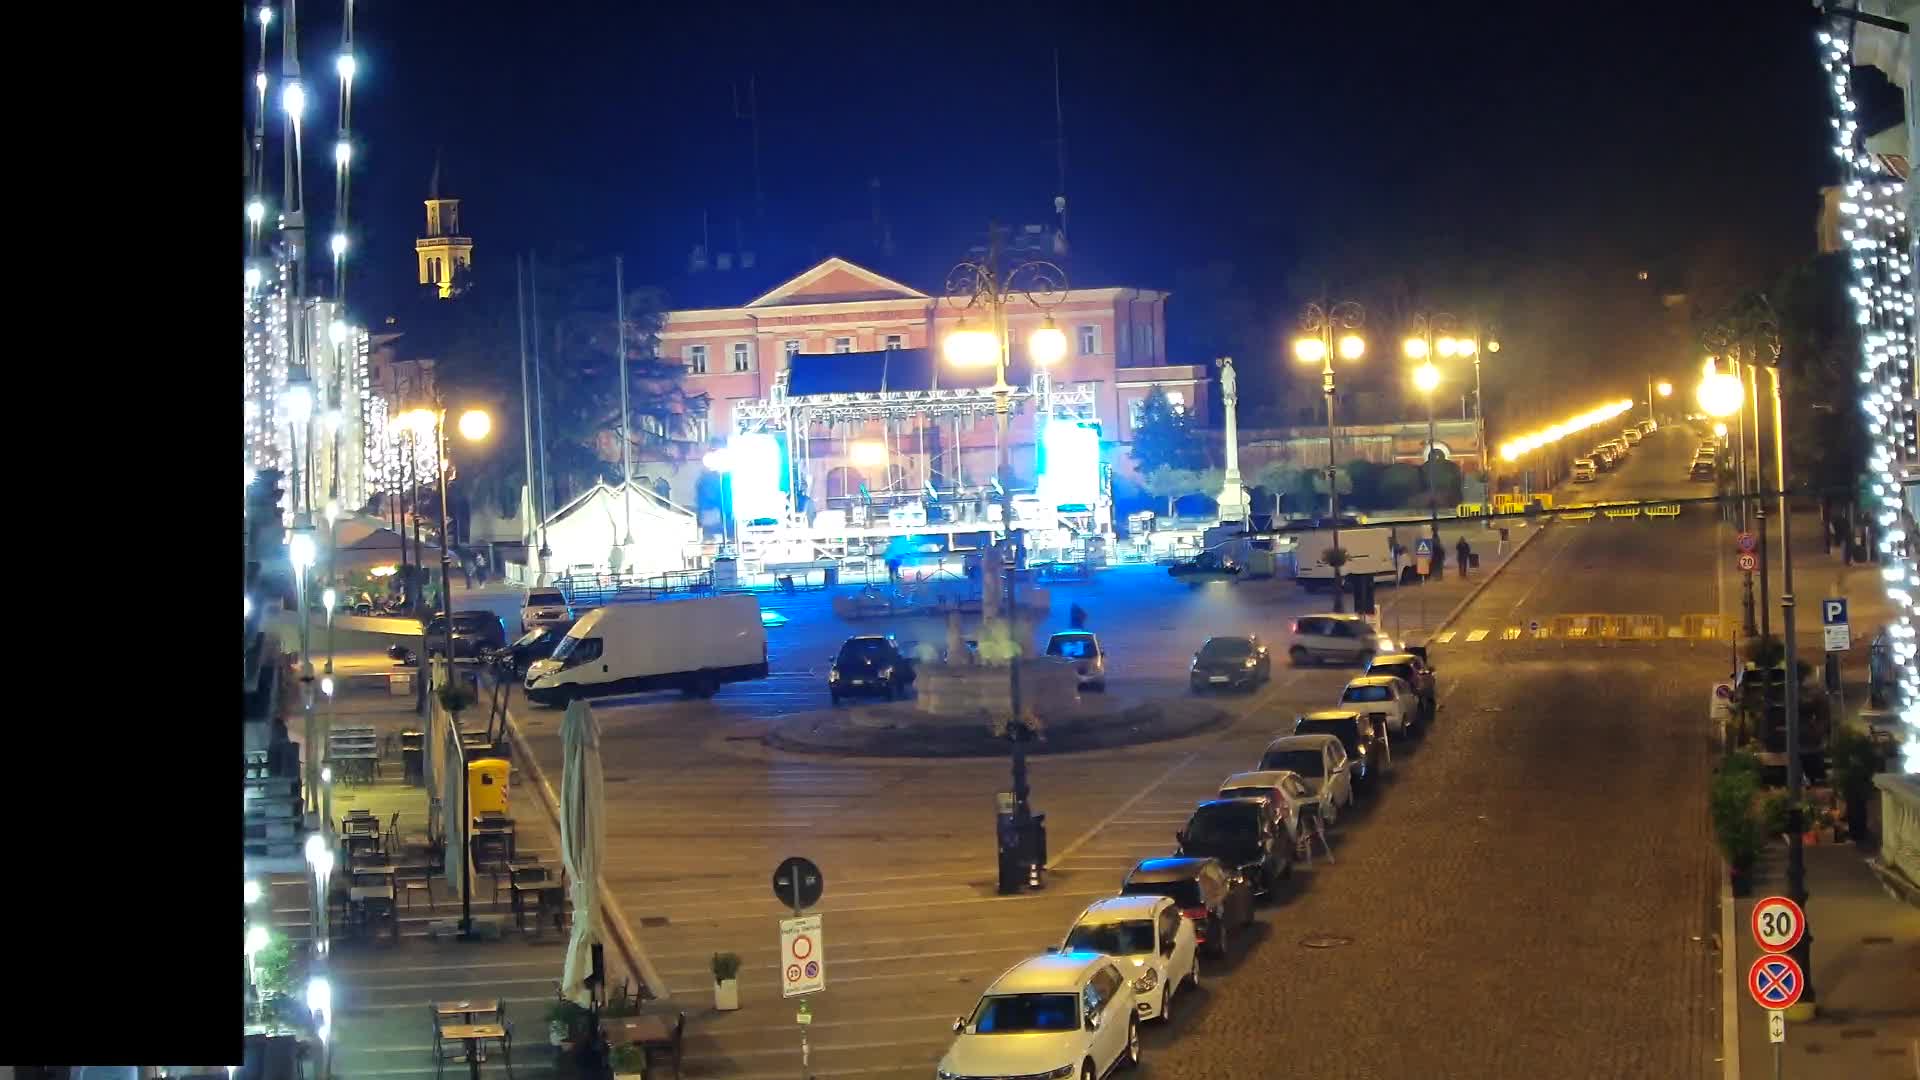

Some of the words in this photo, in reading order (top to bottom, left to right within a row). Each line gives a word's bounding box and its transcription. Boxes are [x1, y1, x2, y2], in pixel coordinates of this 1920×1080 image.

[1742, 558, 1753, 567] 20
[1828, 602, 1842, 622] P
[1762, 912, 1791, 938] 30
